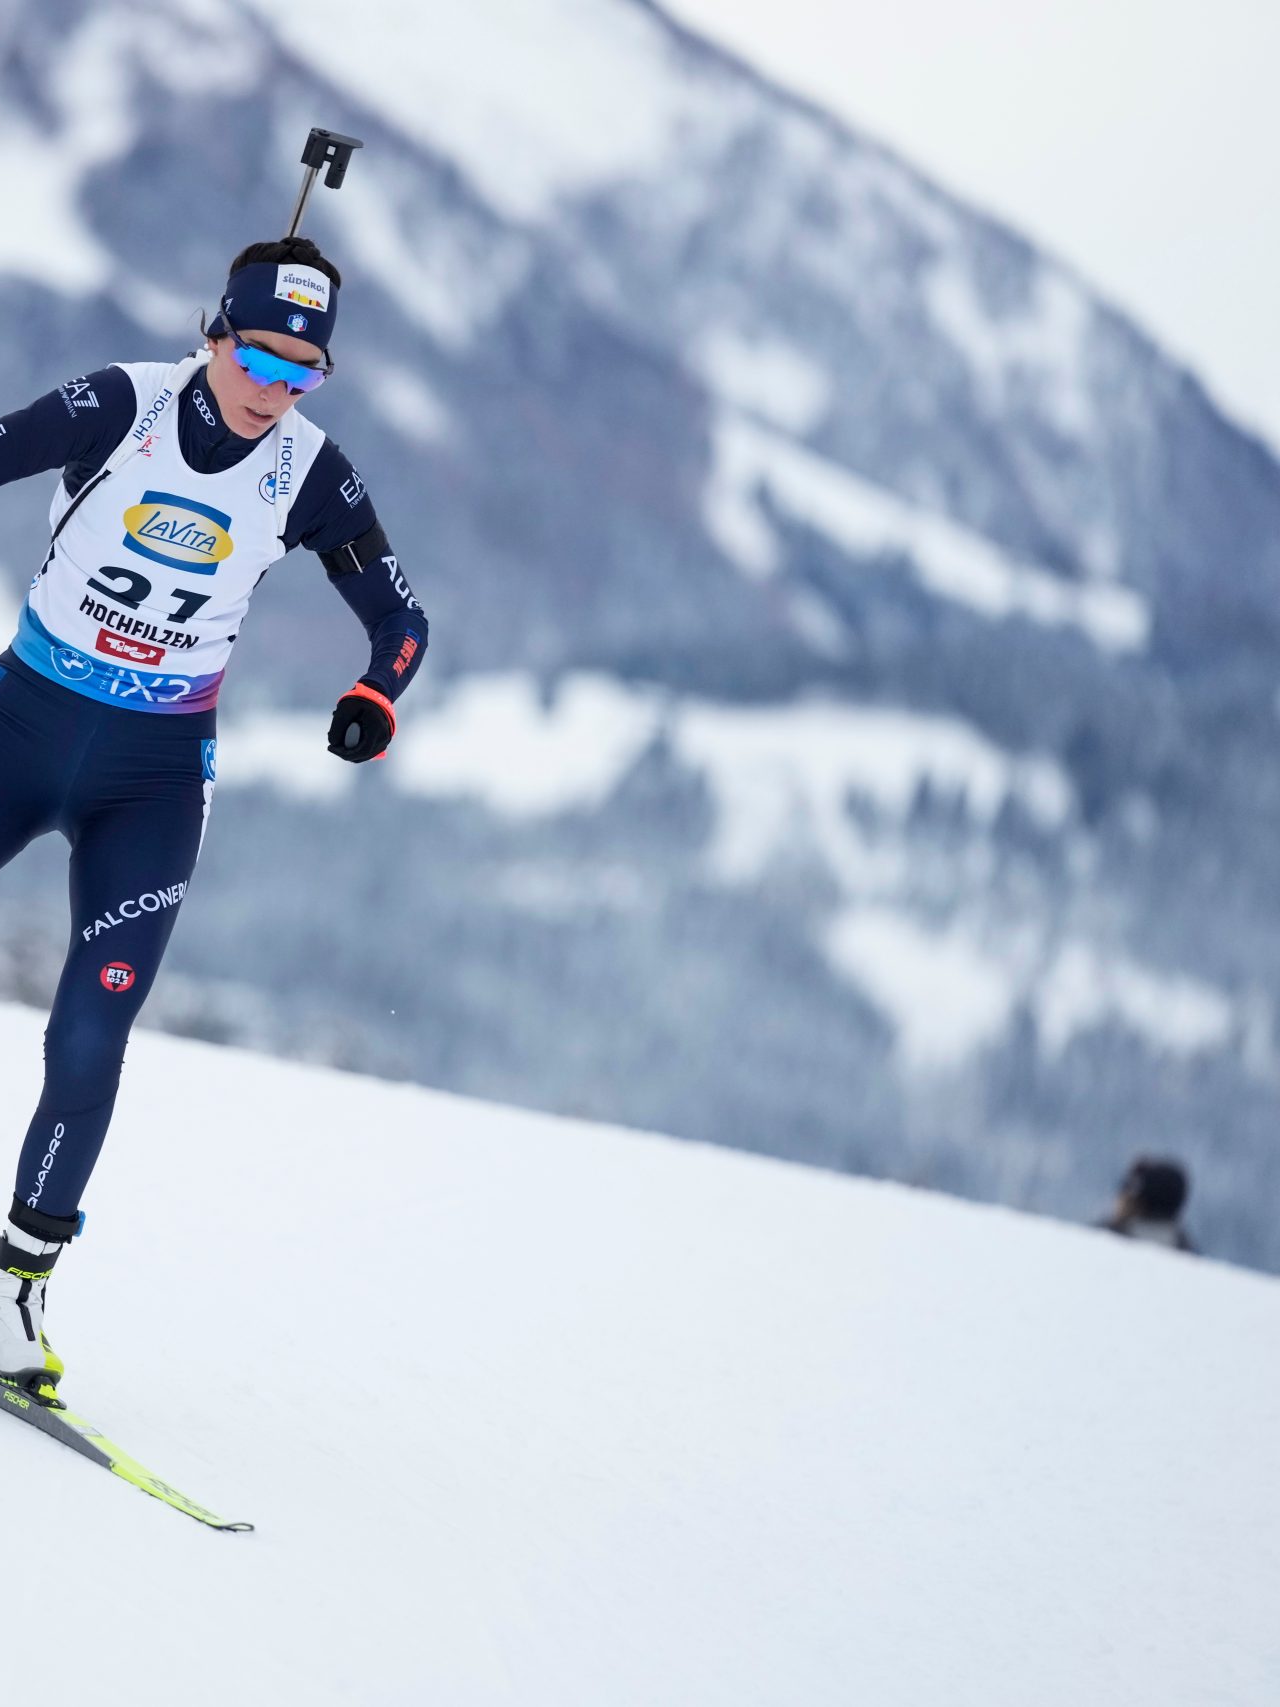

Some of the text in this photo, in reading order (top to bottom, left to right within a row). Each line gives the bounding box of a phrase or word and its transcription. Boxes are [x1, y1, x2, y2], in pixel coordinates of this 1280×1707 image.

[64, 376, 100, 408] A7
[133, 388, 173, 441] FIOCCHI
[278, 437, 293, 495] FIOCCHI
[340, 466, 364, 504] EA
[86, 565, 212, 624] 21
[381, 555, 422, 609] Aud
[79, 594, 200, 649] HOCHFILZEN
[82, 880, 188, 942] FALCONERI
[106, 968, 129, 979] RTL
[106, 977, 128, 985] 102.5
[27, 1122, 65, 1208] QUADRO
[3, 1391, 30, 1410] FISCHER
